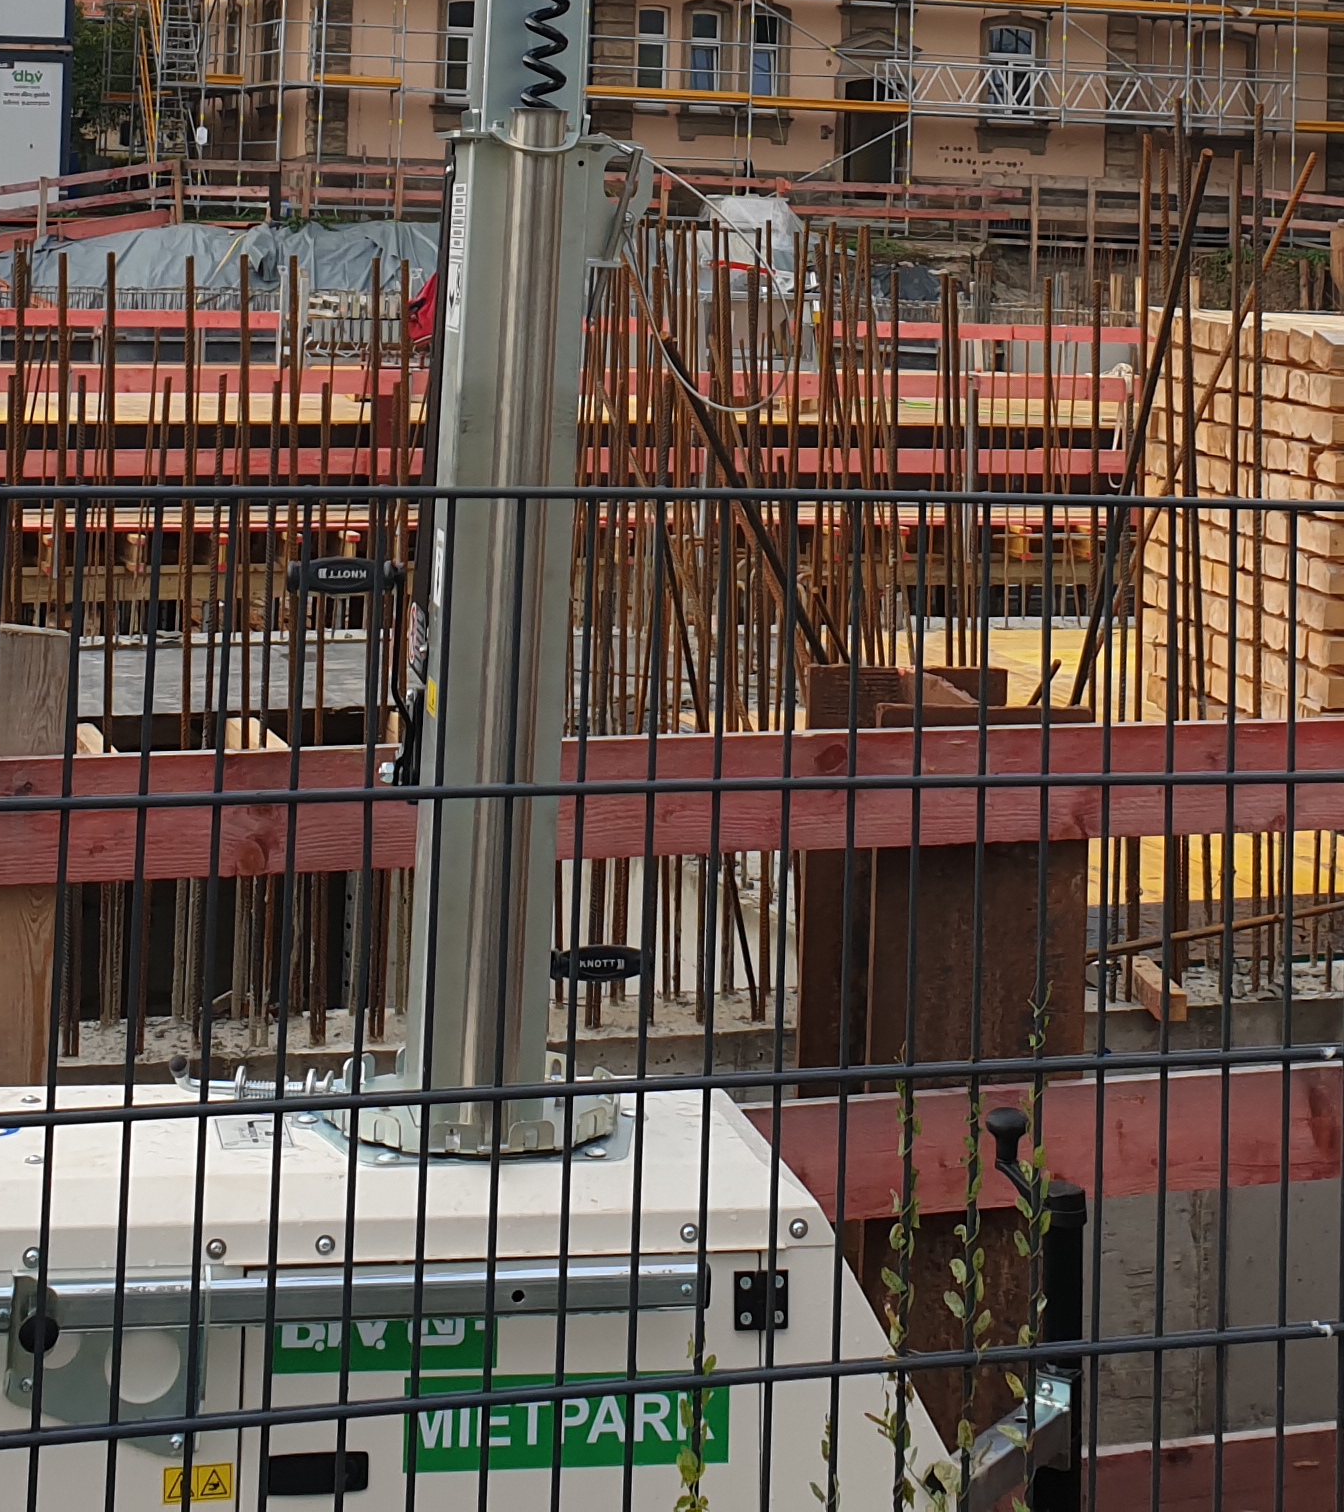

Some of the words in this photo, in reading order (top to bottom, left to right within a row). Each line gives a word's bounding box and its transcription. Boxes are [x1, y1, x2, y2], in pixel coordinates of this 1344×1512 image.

[12, 70, 43, 84] dbv
[328, 569, 367, 579] KNOTT
[579, 958, 616, 969] KNOTT
